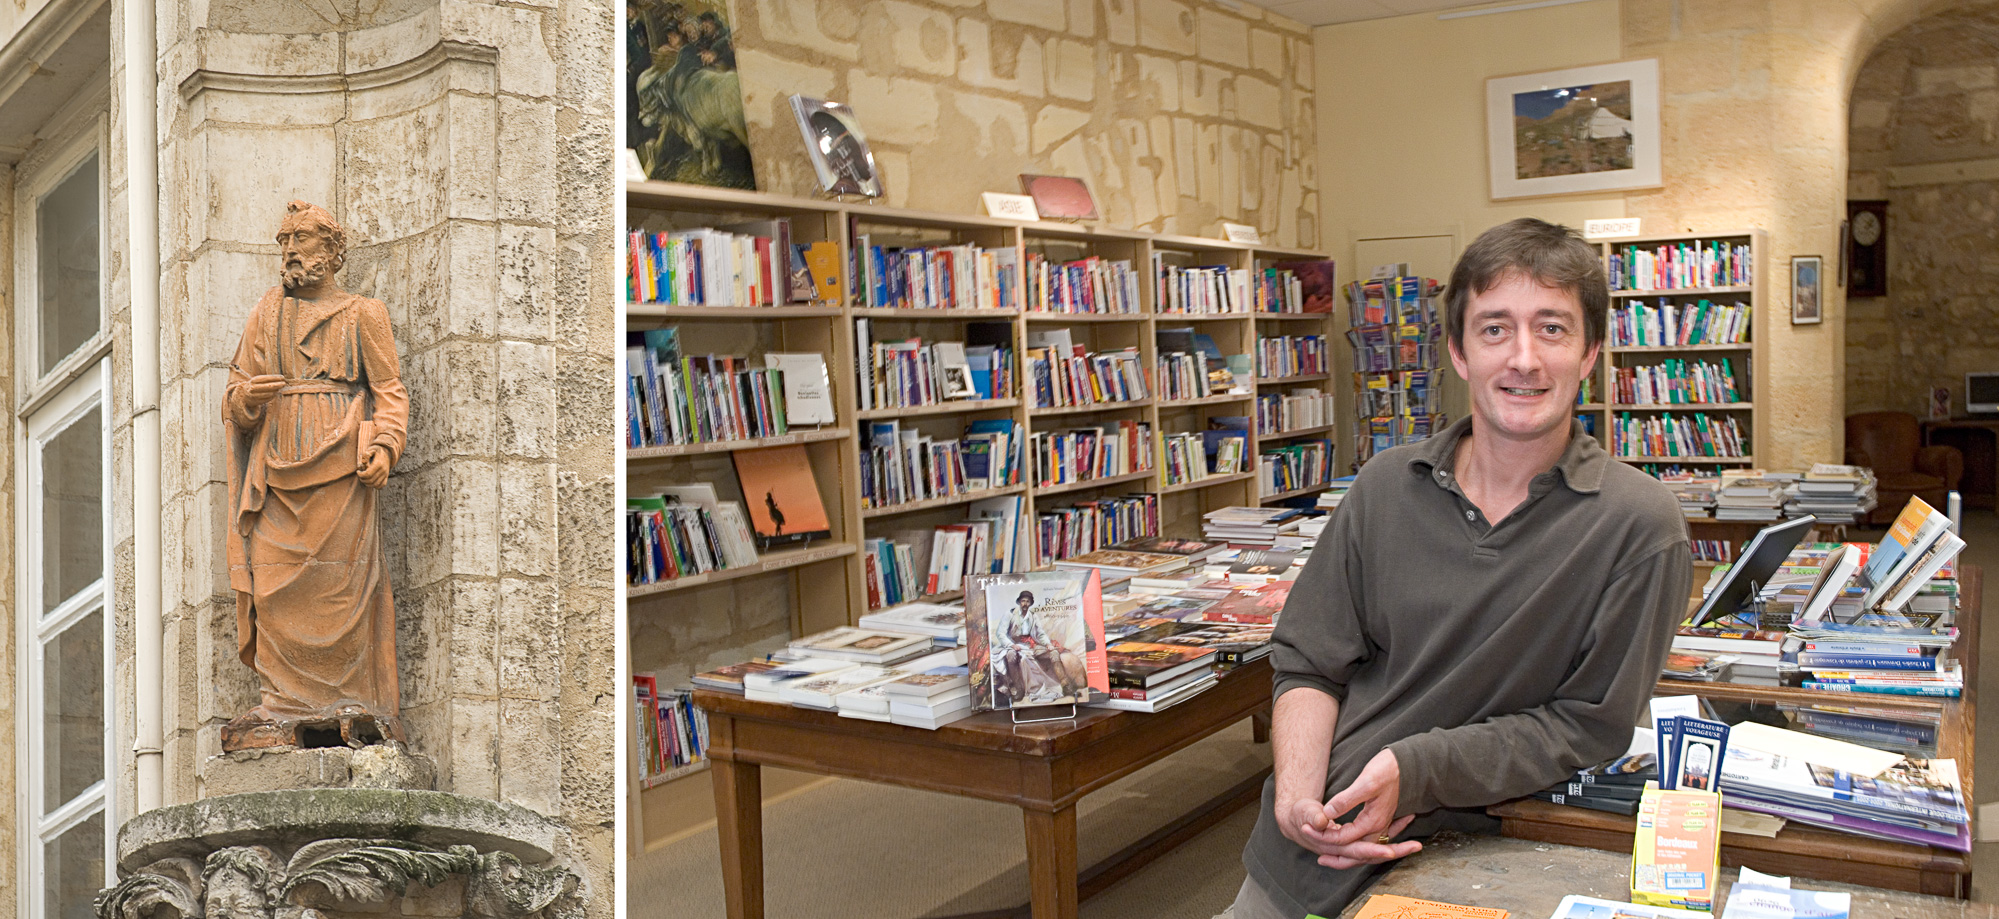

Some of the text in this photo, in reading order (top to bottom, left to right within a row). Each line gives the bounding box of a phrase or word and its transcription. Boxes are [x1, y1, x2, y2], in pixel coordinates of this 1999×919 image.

[1588, 222, 1635, 234] EUROPE
[1823, 682, 1850, 692] CROATIE
[1685, 727, 1721, 738] VOYAGEUSE
[1656, 835, 1698, 849] Bordeaux
